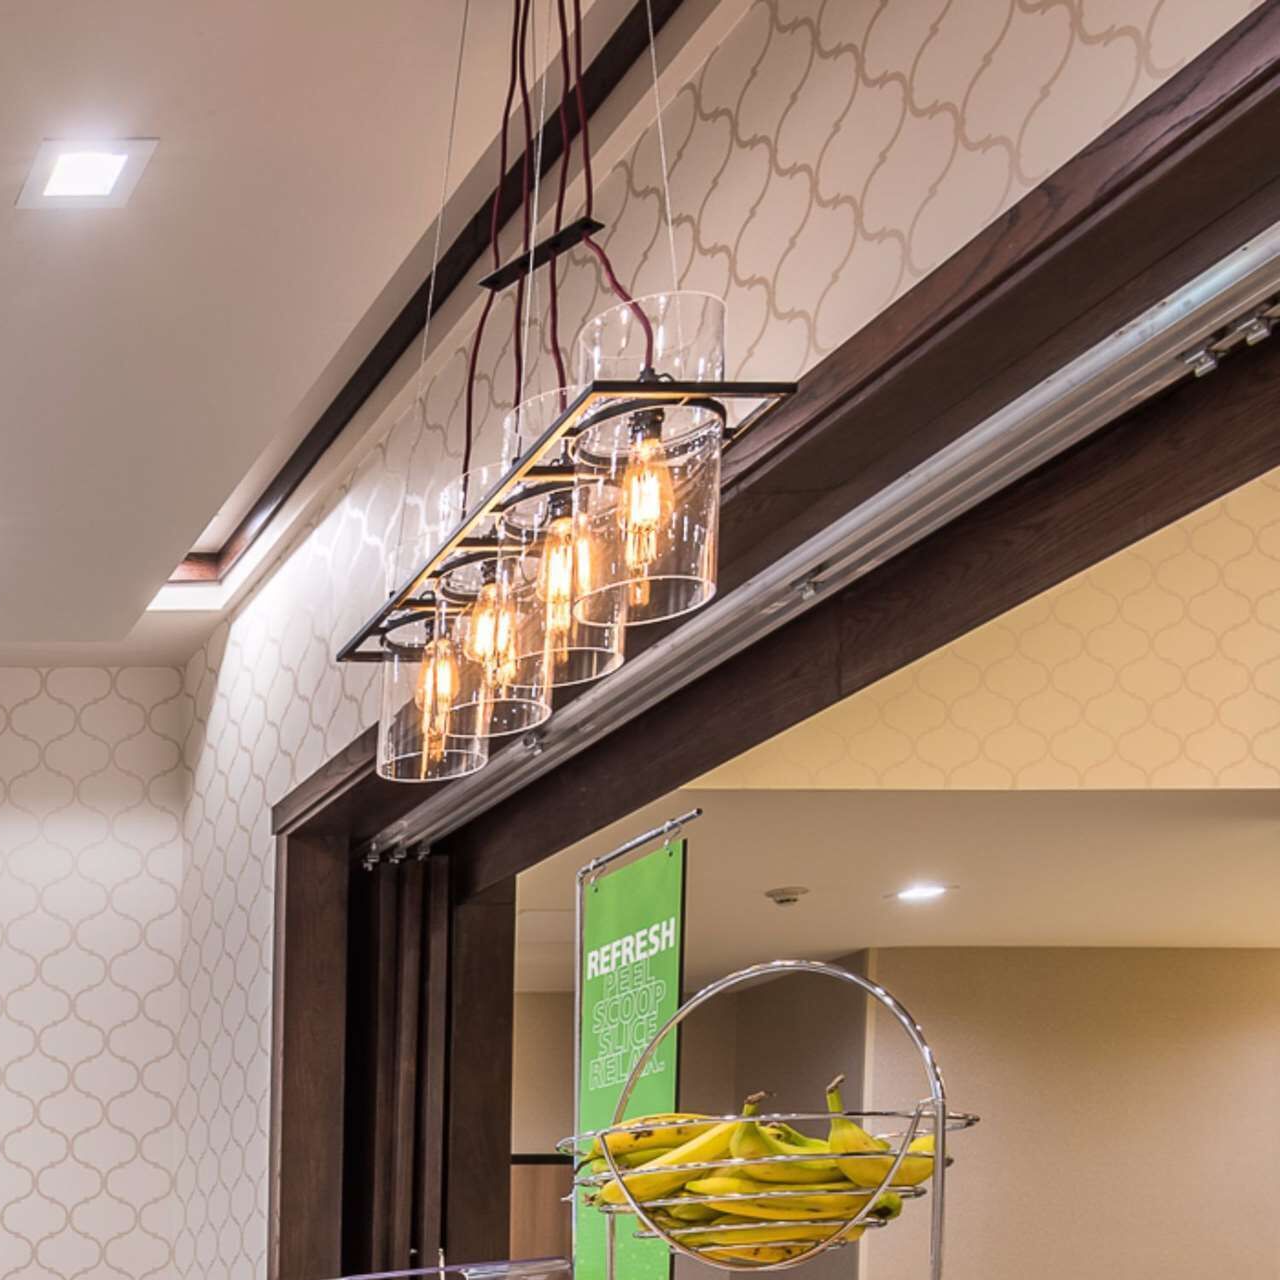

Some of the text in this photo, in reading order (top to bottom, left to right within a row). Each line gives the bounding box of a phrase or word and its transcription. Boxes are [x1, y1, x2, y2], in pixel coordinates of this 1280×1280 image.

[587, 917, 676, 981] REFRESH
[603, 957, 656, 999] PEEL
[592, 979, 666, 1034] SCOOP
[599, 1012, 657, 1057] SLICE
